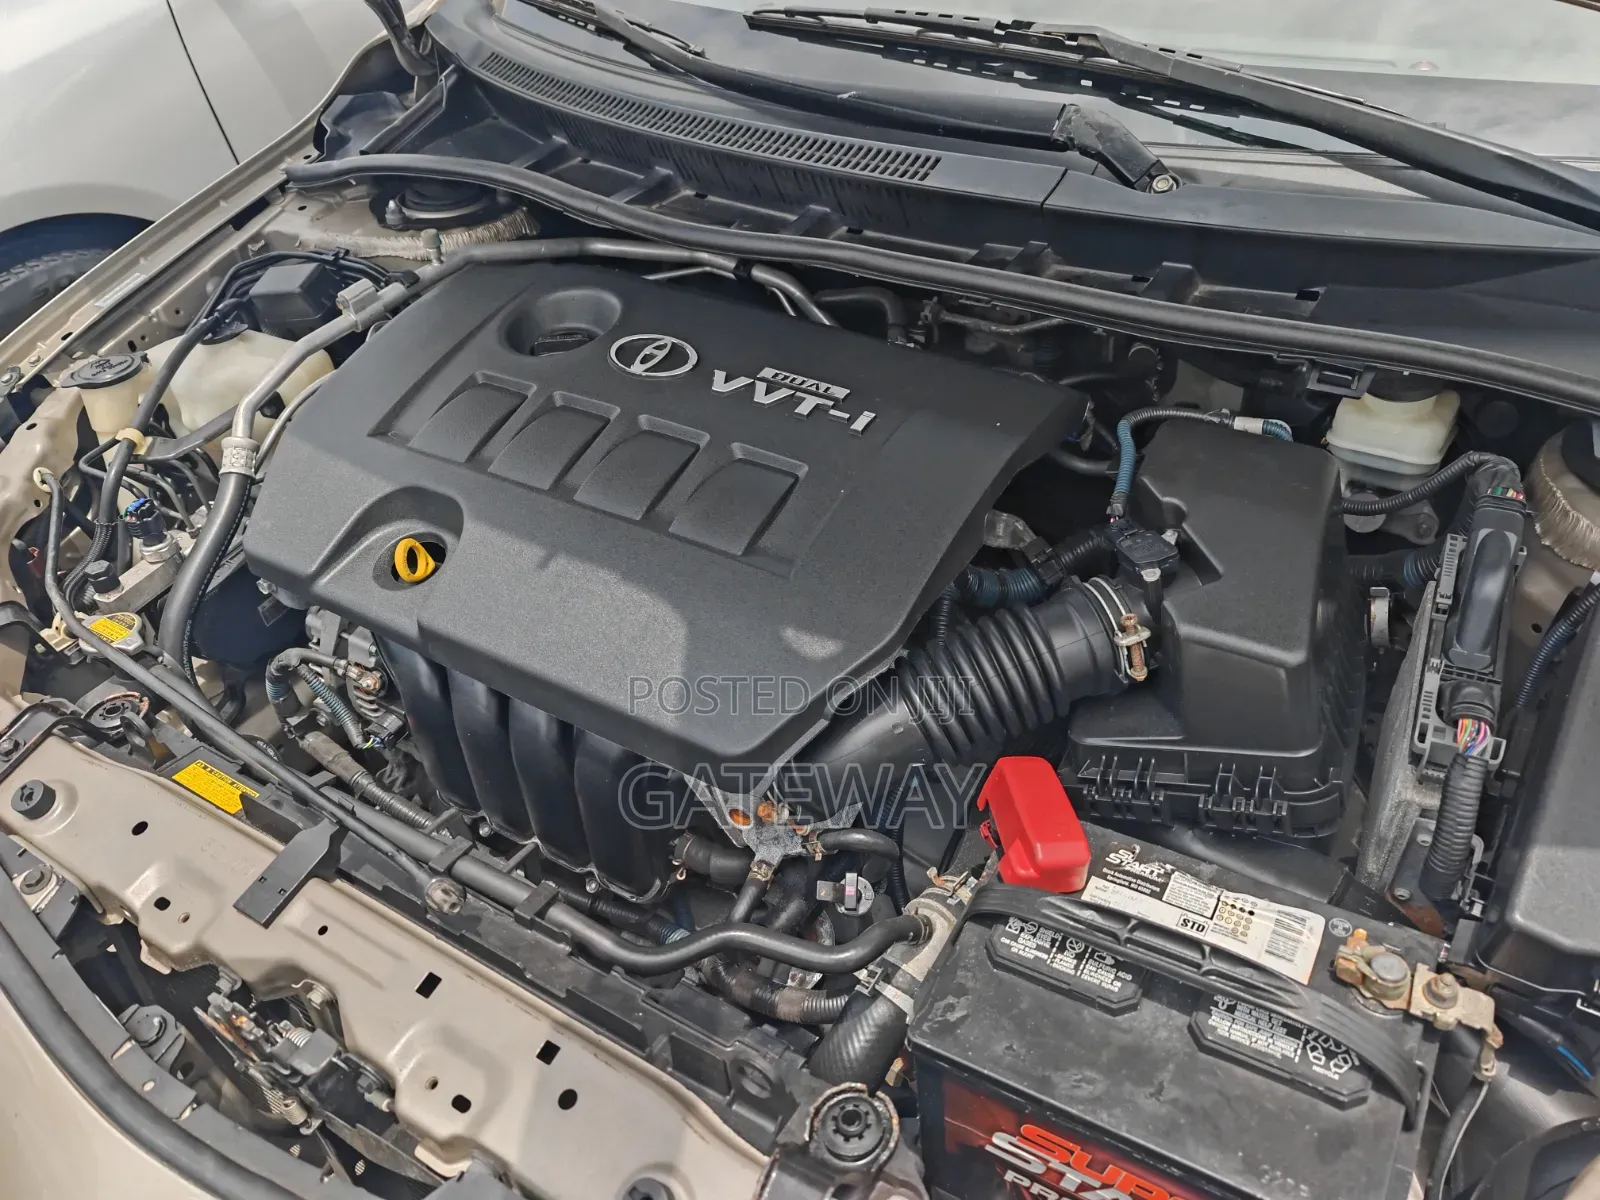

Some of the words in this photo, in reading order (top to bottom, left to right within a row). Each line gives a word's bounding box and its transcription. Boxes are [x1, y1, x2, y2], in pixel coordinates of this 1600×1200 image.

[770, 372, 837, 396] DUAL
[1105, 852, 1165, 877] START
[1180, 918, 1206, 933] STD
[1085, 963, 1097, 972] CAN
[1088, 959, 1117, 974] SULFURIC
[1116, 970, 1133, 981] ACID
[1112, 980, 1122, 988] OR
